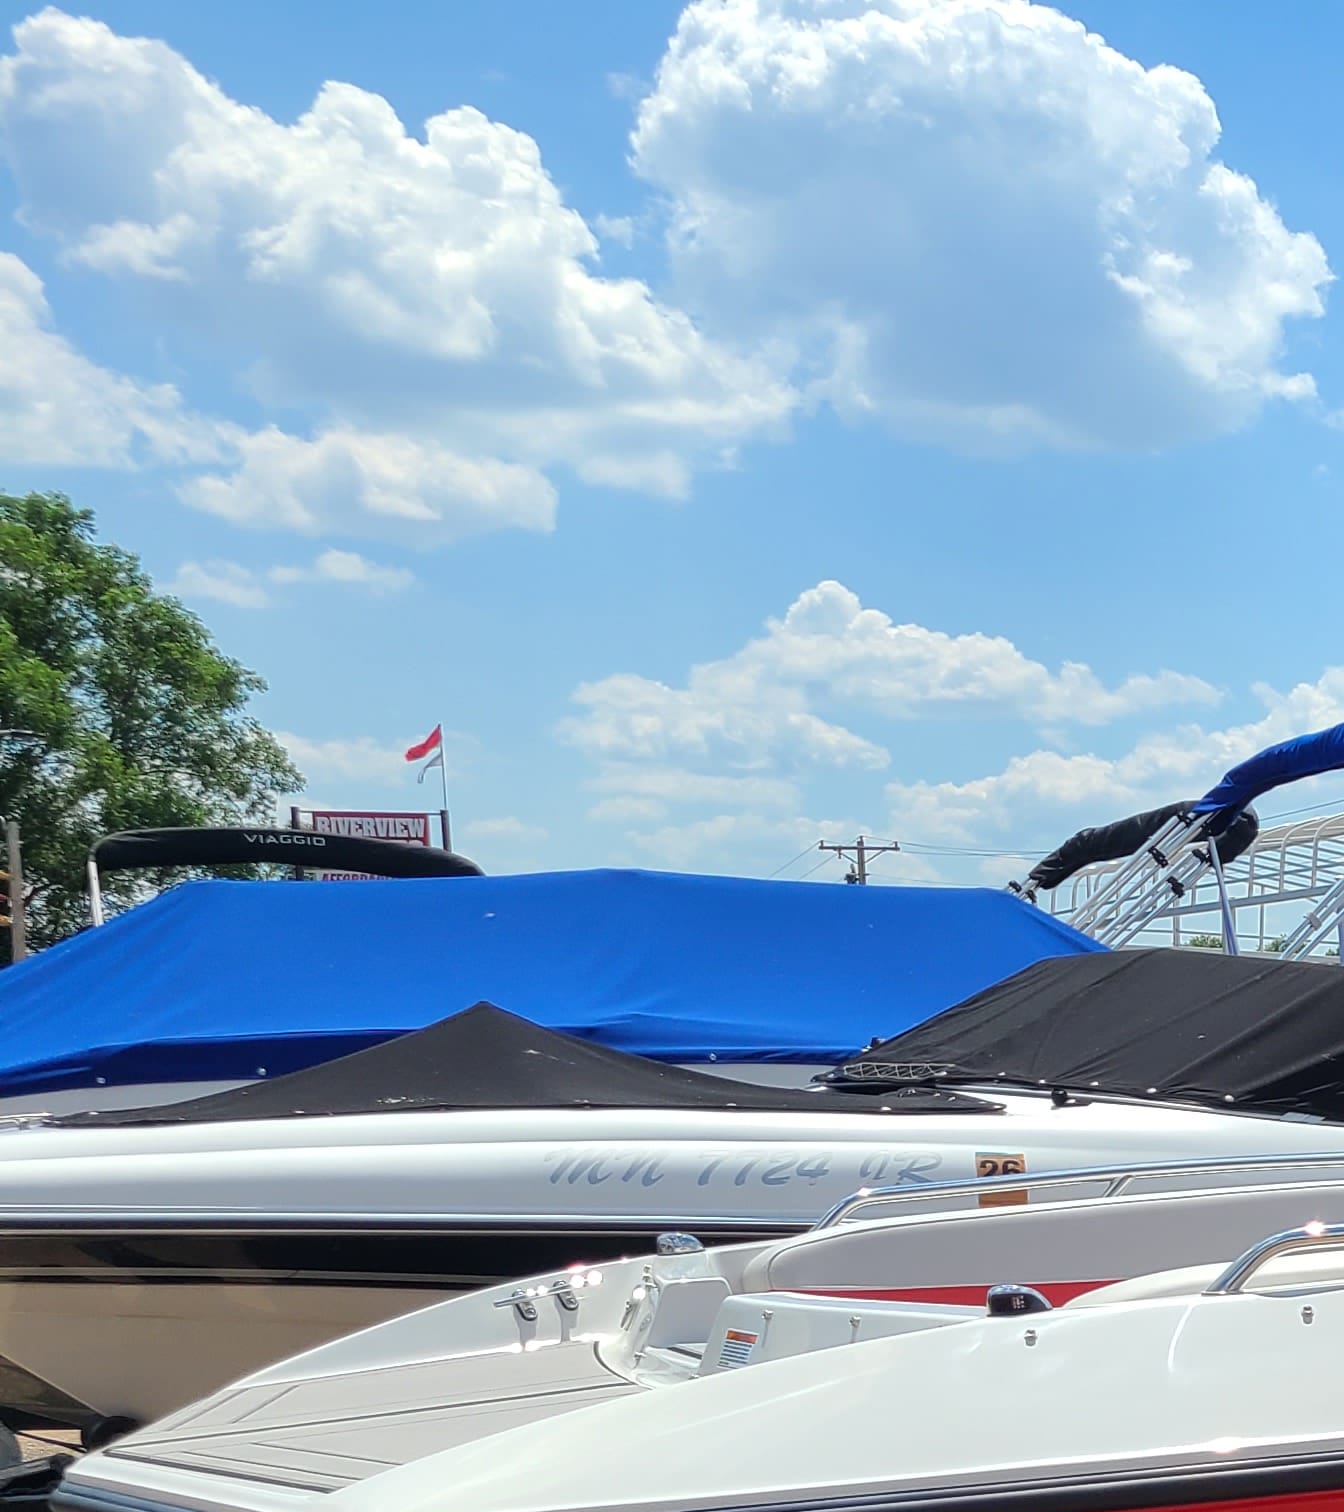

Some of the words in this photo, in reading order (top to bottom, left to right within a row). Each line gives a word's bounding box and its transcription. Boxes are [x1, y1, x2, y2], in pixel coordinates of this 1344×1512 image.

[316, 816, 425, 838] RIVERVIEW
[243, 832, 327, 847] VIAGGIO
[544, 1148, 671, 1187] MN
[697, 1149, 833, 1186] 7724
